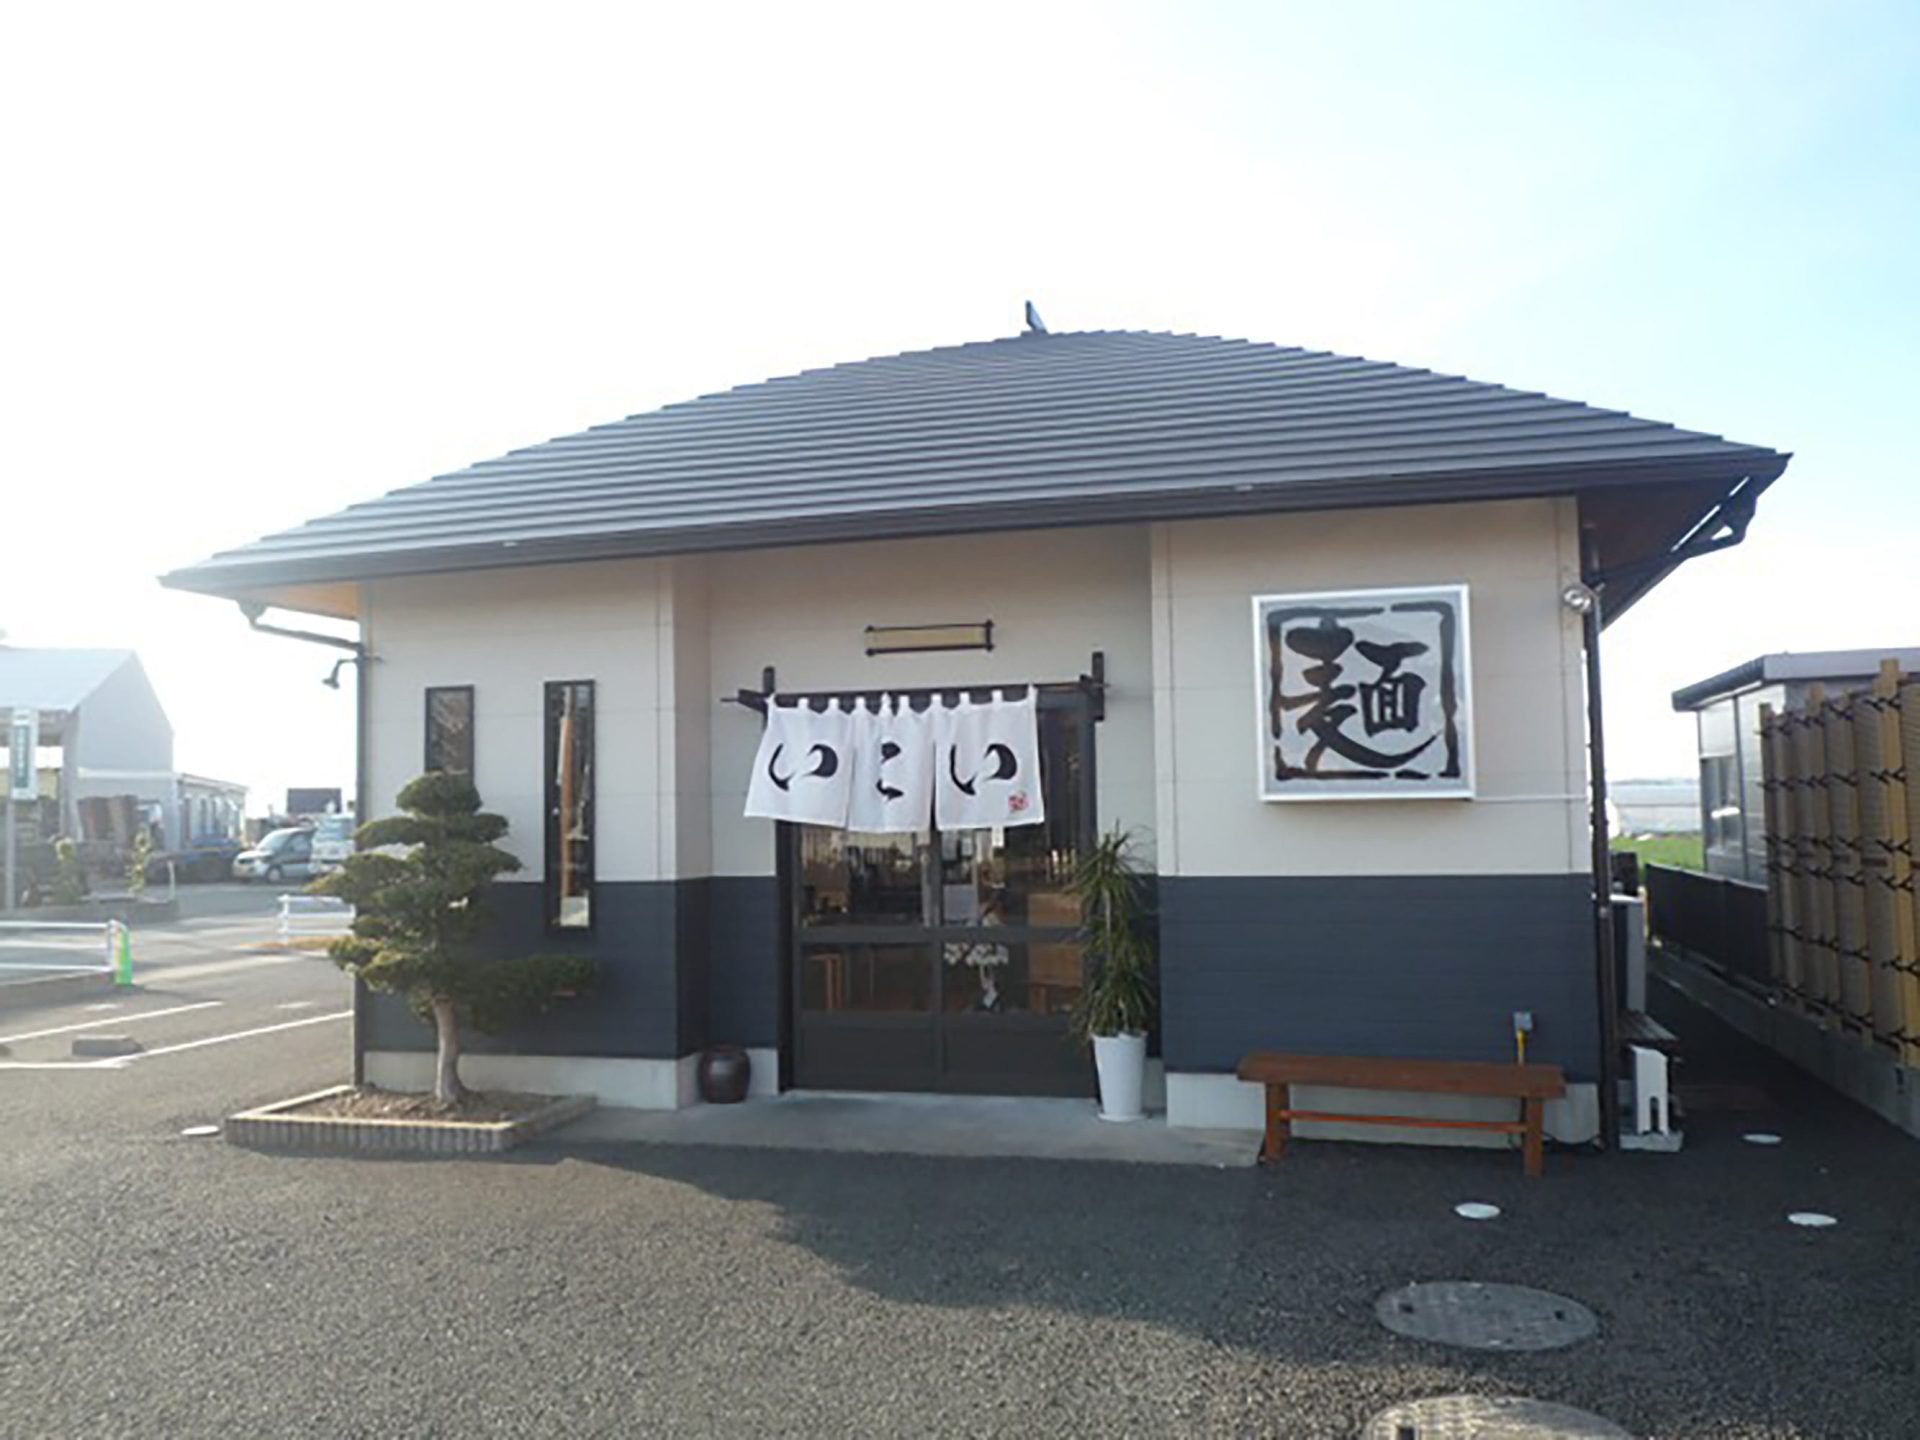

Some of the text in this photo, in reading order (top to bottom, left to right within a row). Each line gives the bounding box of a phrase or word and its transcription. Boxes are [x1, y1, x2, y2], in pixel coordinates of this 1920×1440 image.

[1284, 616, 1442, 772] 麺
[768, 740, 1018, 800] いこい
